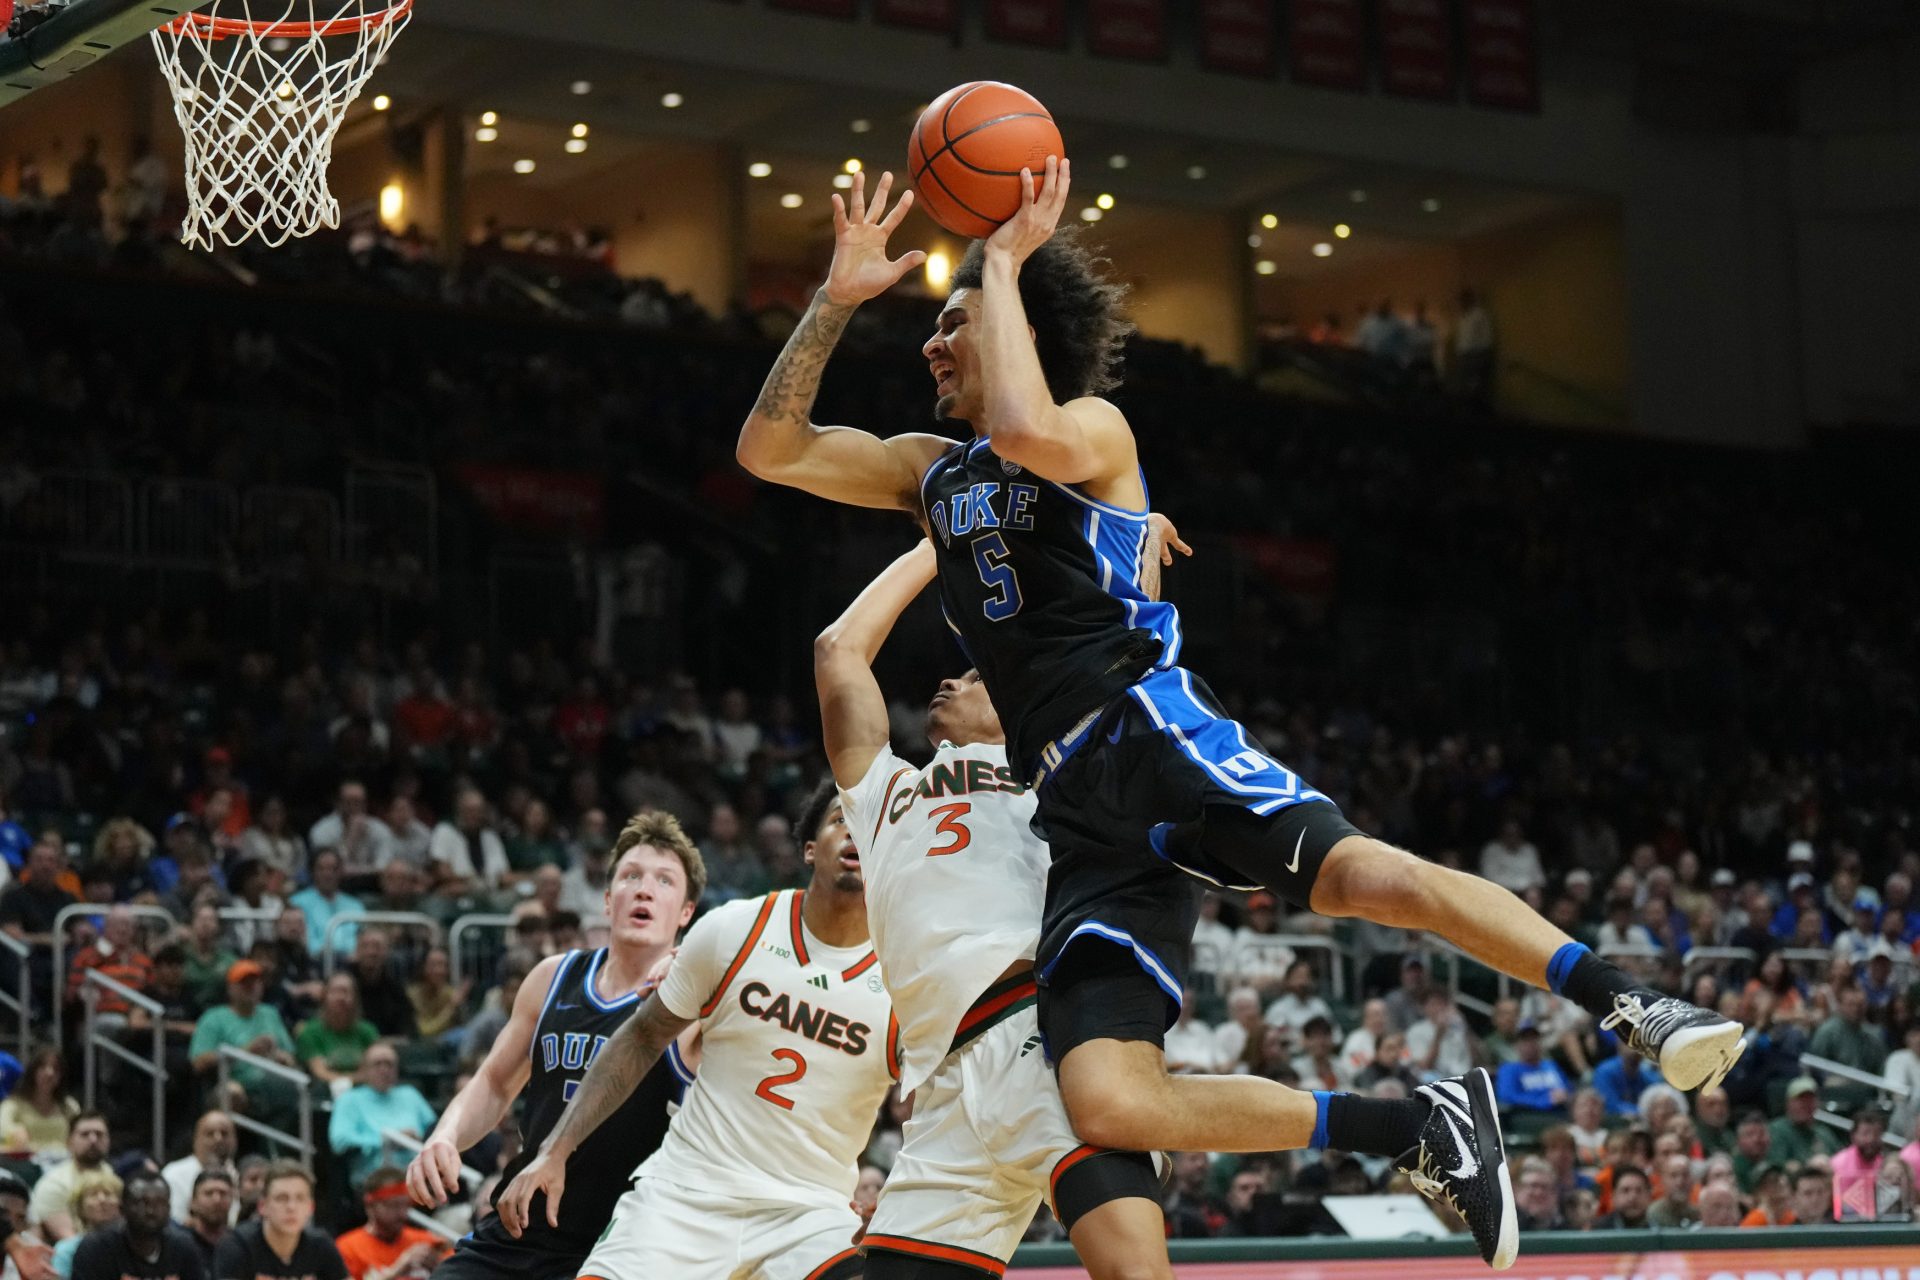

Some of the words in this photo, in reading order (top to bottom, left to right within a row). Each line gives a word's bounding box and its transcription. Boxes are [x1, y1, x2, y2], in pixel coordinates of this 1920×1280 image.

[931, 482, 1039, 549] DUKE
[971, 531, 1023, 622] 5
[889, 759, 1025, 825] CANES
[926, 802, 971, 857] 3
[739, 981, 872, 1056] CANES
[541, 1032, 609, 1072] DU
[754, 1047, 807, 1111] 2
